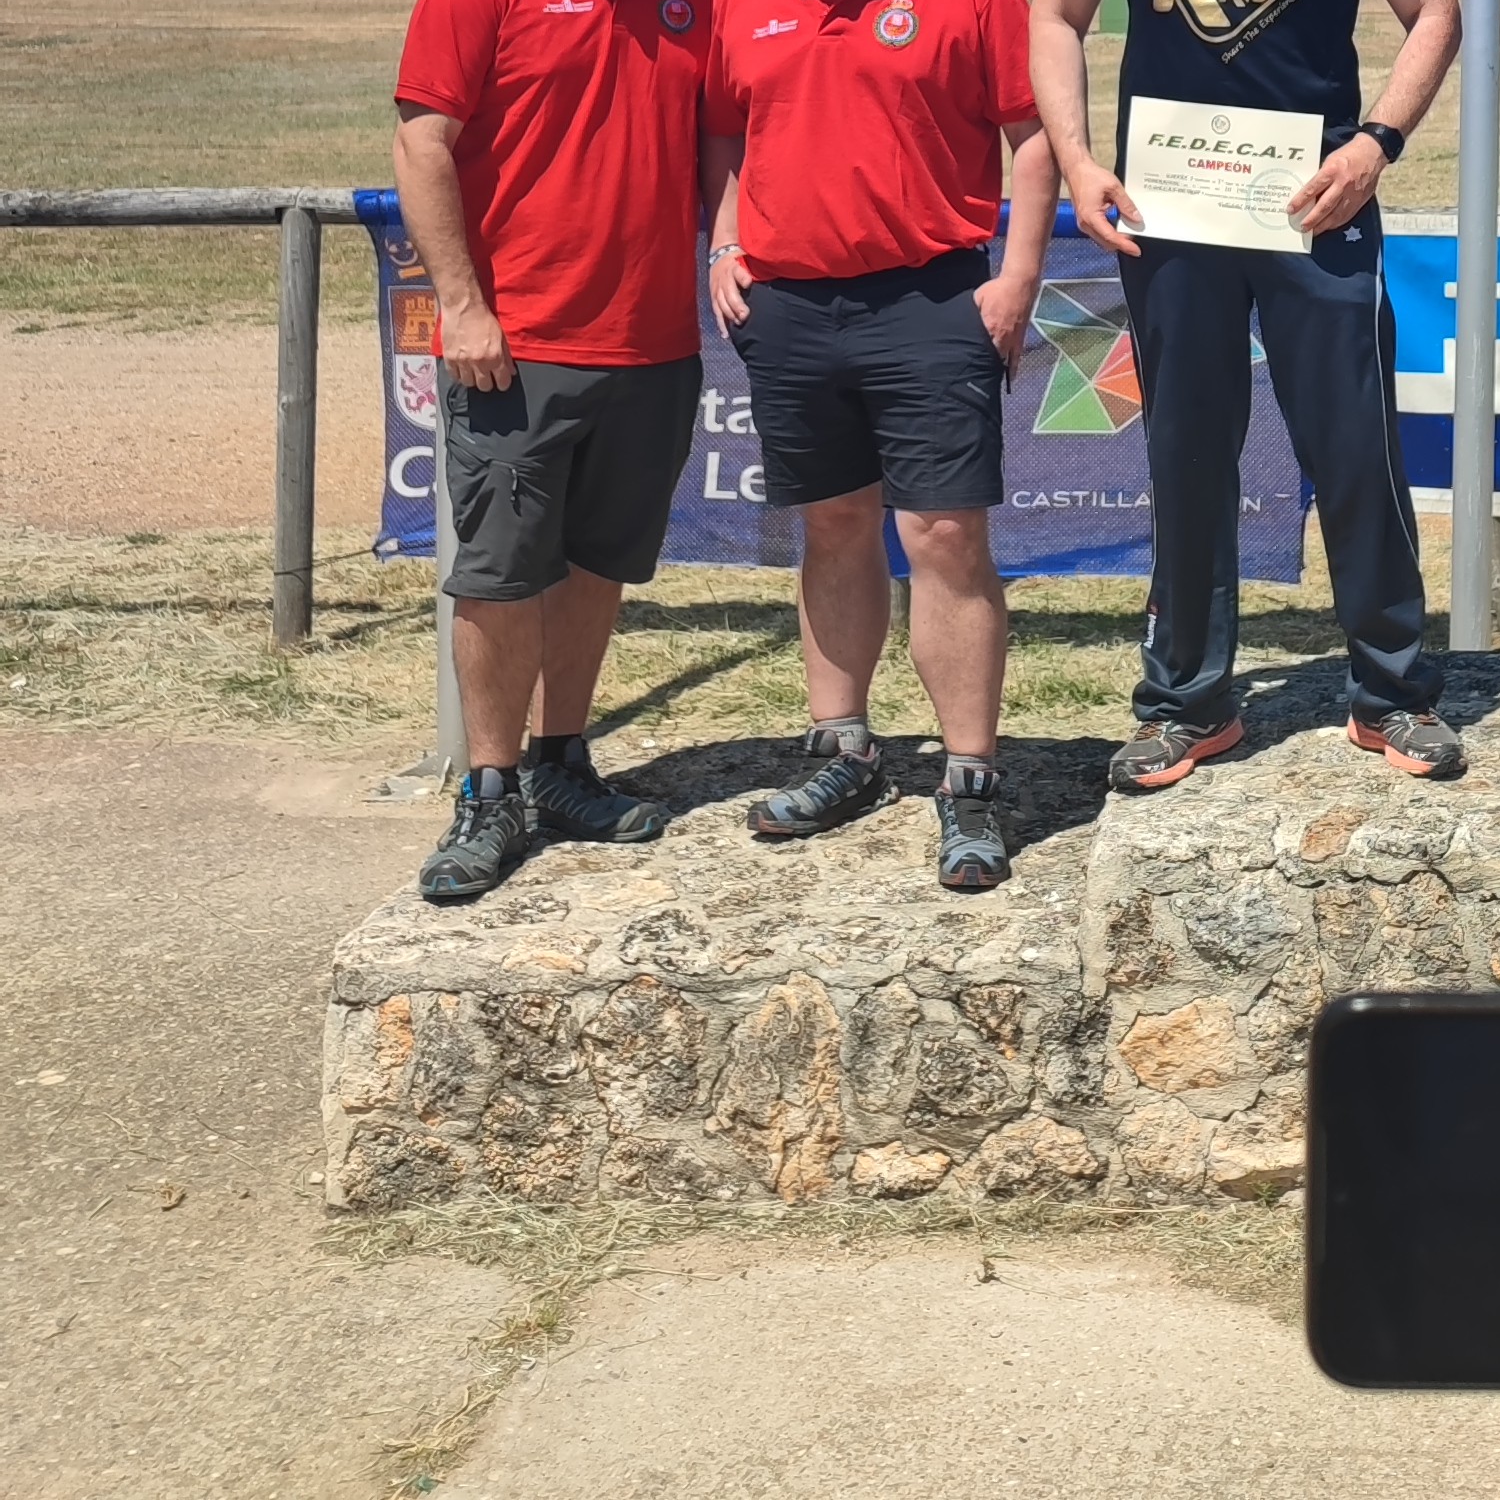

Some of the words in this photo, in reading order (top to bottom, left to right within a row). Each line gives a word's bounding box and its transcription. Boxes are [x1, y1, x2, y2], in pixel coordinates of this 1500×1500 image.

[1221, 40, 1245, 65] Share
[1242, 24, 1260, 43] The
[1147, 133, 1305, 161] F.E.D.E.C.A.T.
[1187, 157, 1252, 174] CAMPEÓN
[1012, 490, 1151, 509] CASTILLA
